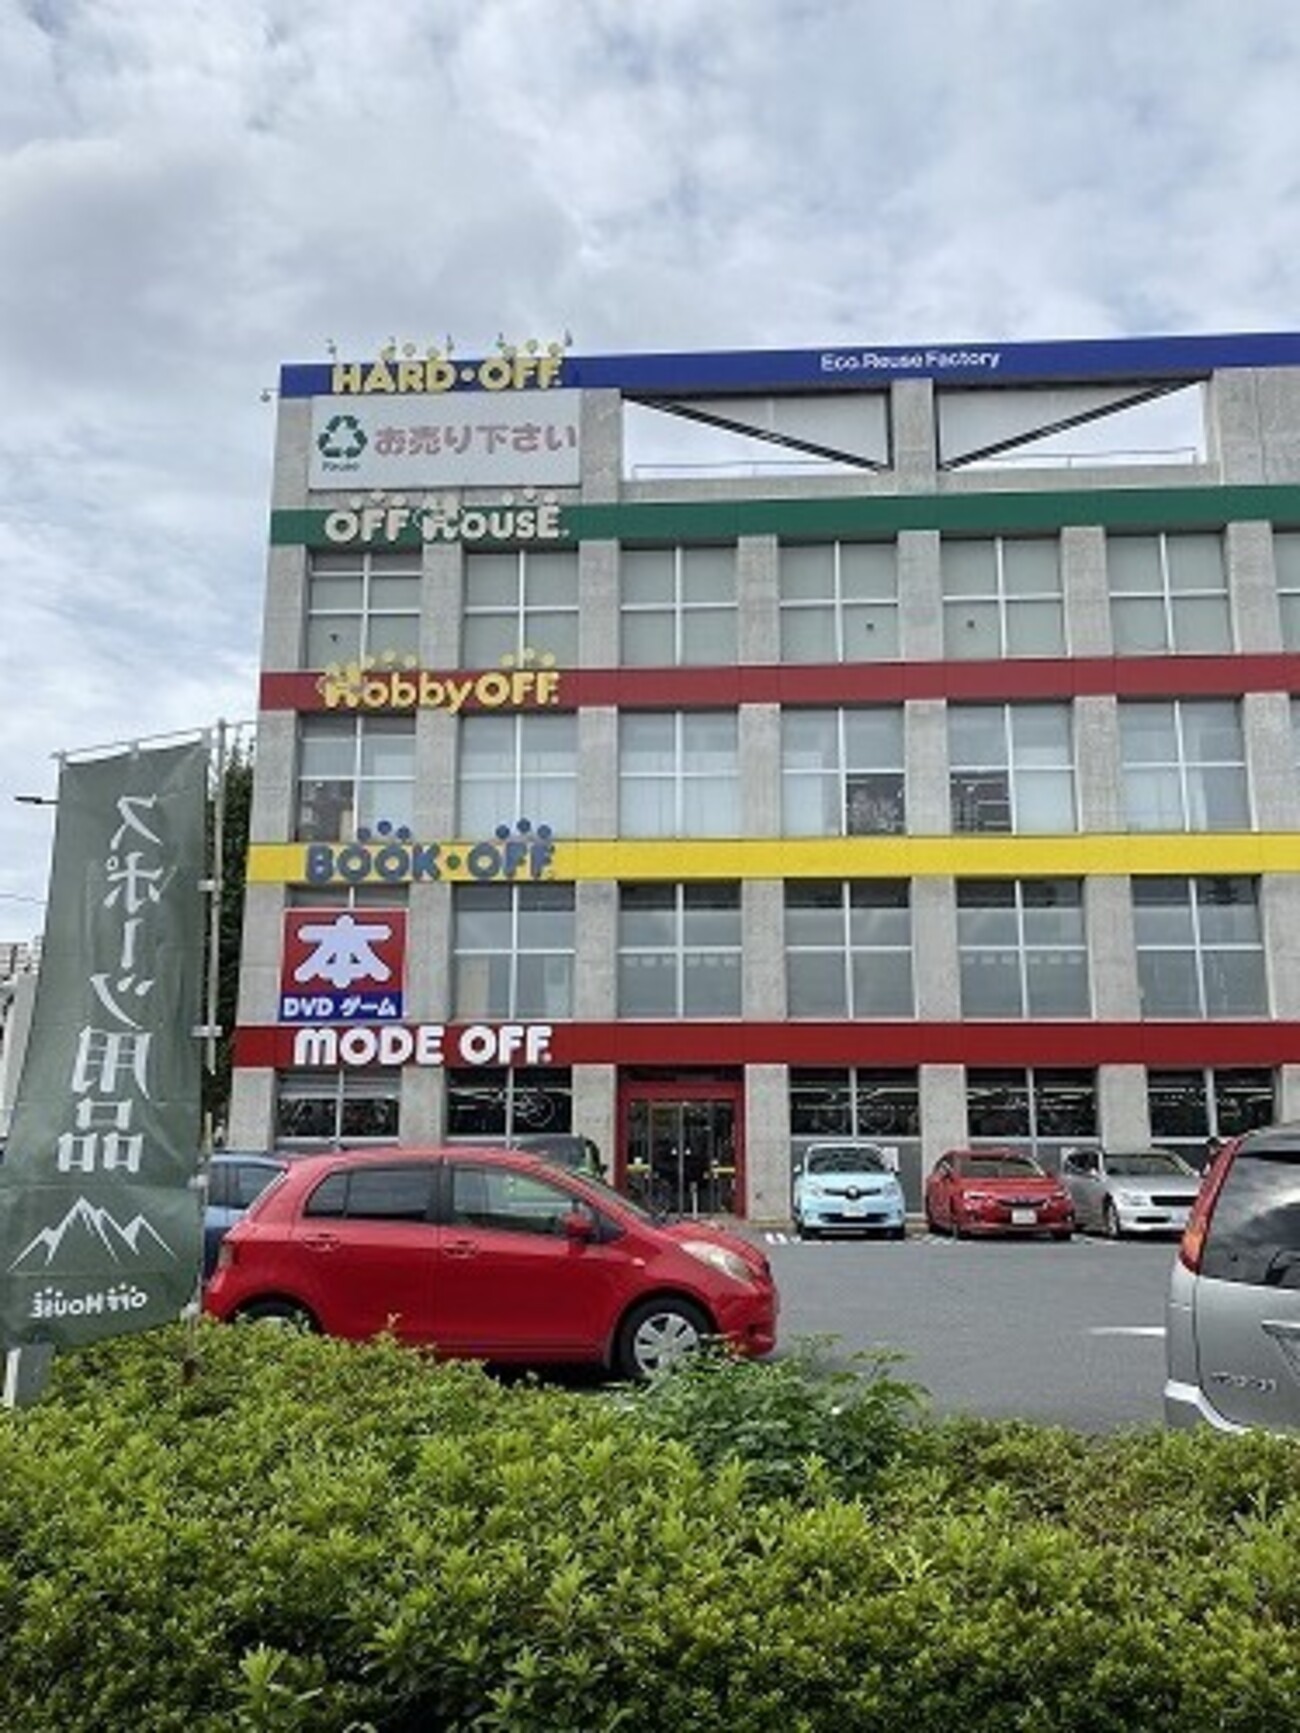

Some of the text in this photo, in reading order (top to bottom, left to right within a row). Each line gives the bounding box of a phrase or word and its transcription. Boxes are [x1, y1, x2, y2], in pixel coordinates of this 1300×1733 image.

[926, 350, 1001, 368] Factory
[374, 424, 578, 457] お売り下さい
[325, 508, 409, 543] OFF
[294, 914, 392, 989] 本
[283, 998, 333, 1018] DVD
[294, 1025, 445, 1066] MODE
